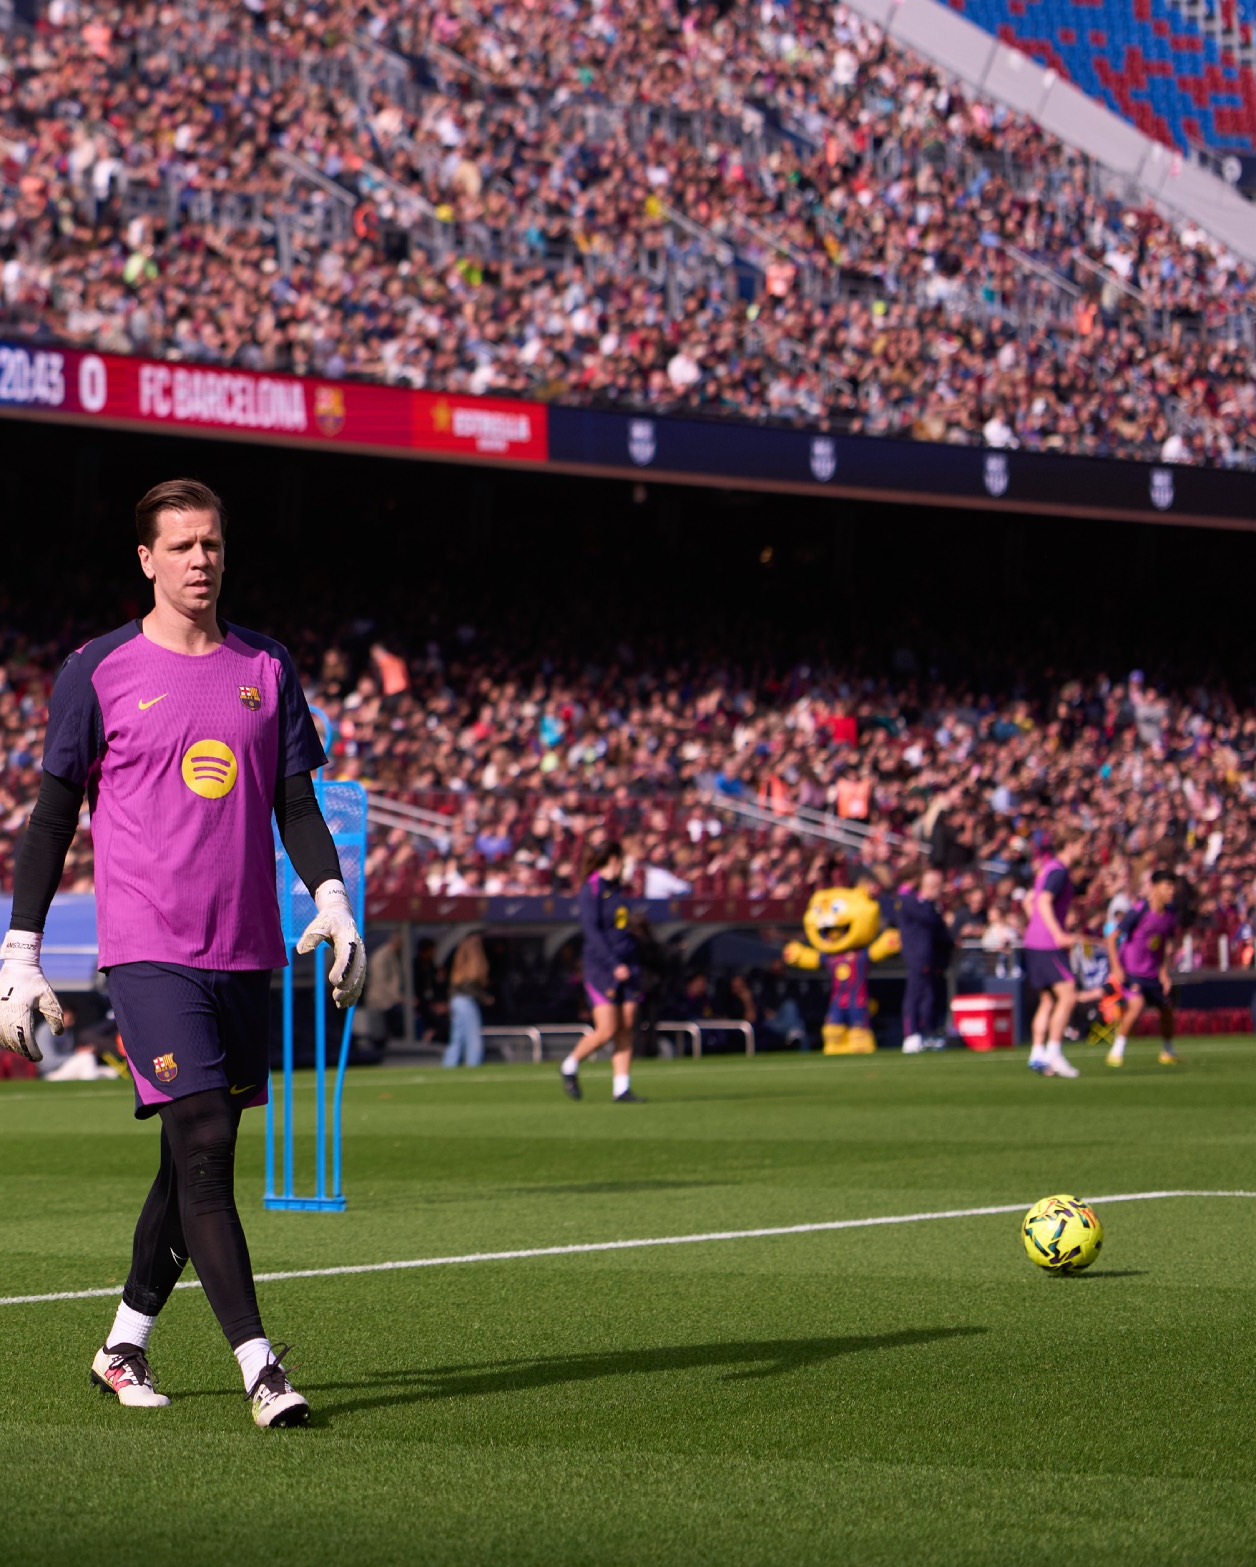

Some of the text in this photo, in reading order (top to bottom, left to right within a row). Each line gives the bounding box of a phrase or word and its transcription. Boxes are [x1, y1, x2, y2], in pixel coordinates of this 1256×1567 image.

[78, 353, 107, 413] 0
[138, 363, 171, 418] FC
[172, 366, 308, 433] BARCELONA
